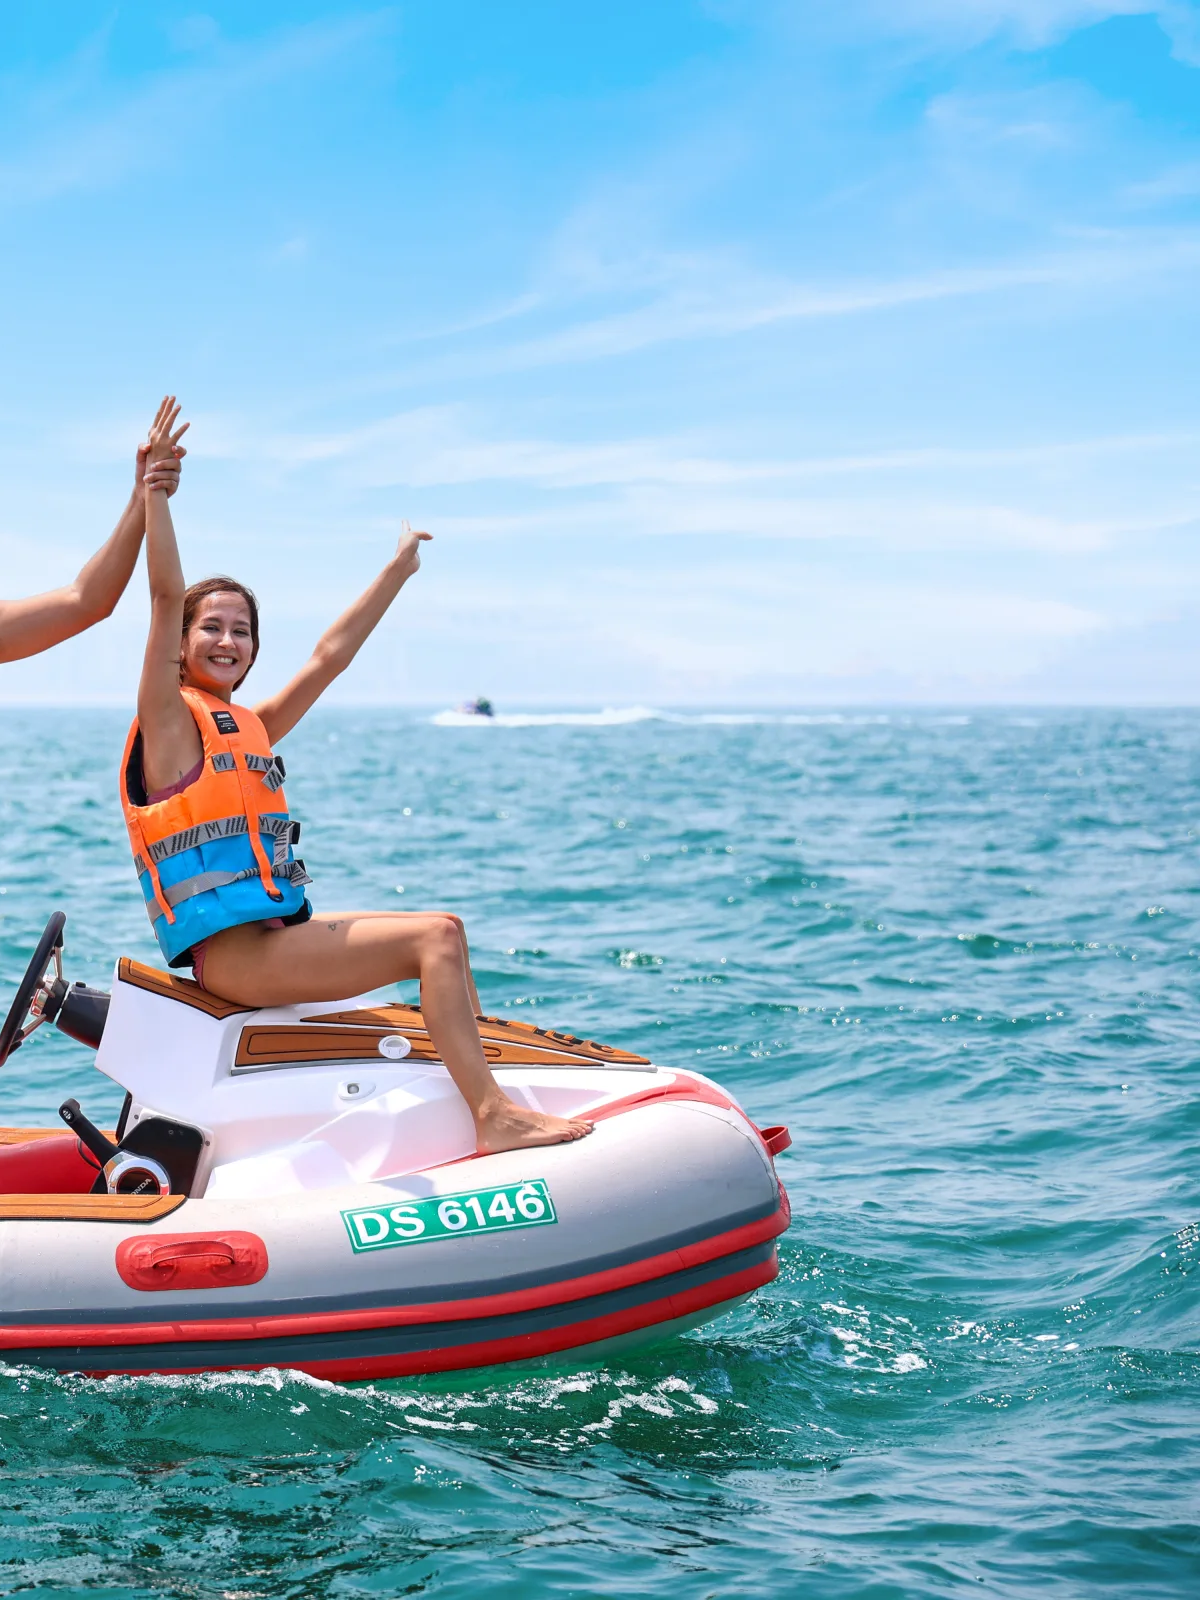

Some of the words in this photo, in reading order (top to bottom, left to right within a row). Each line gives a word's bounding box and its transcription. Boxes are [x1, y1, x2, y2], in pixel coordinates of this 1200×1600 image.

[130, 1178, 152, 1195] ONDA
[352, 1206, 425, 1244] DS
[437, 1187, 545, 1231] 6146
